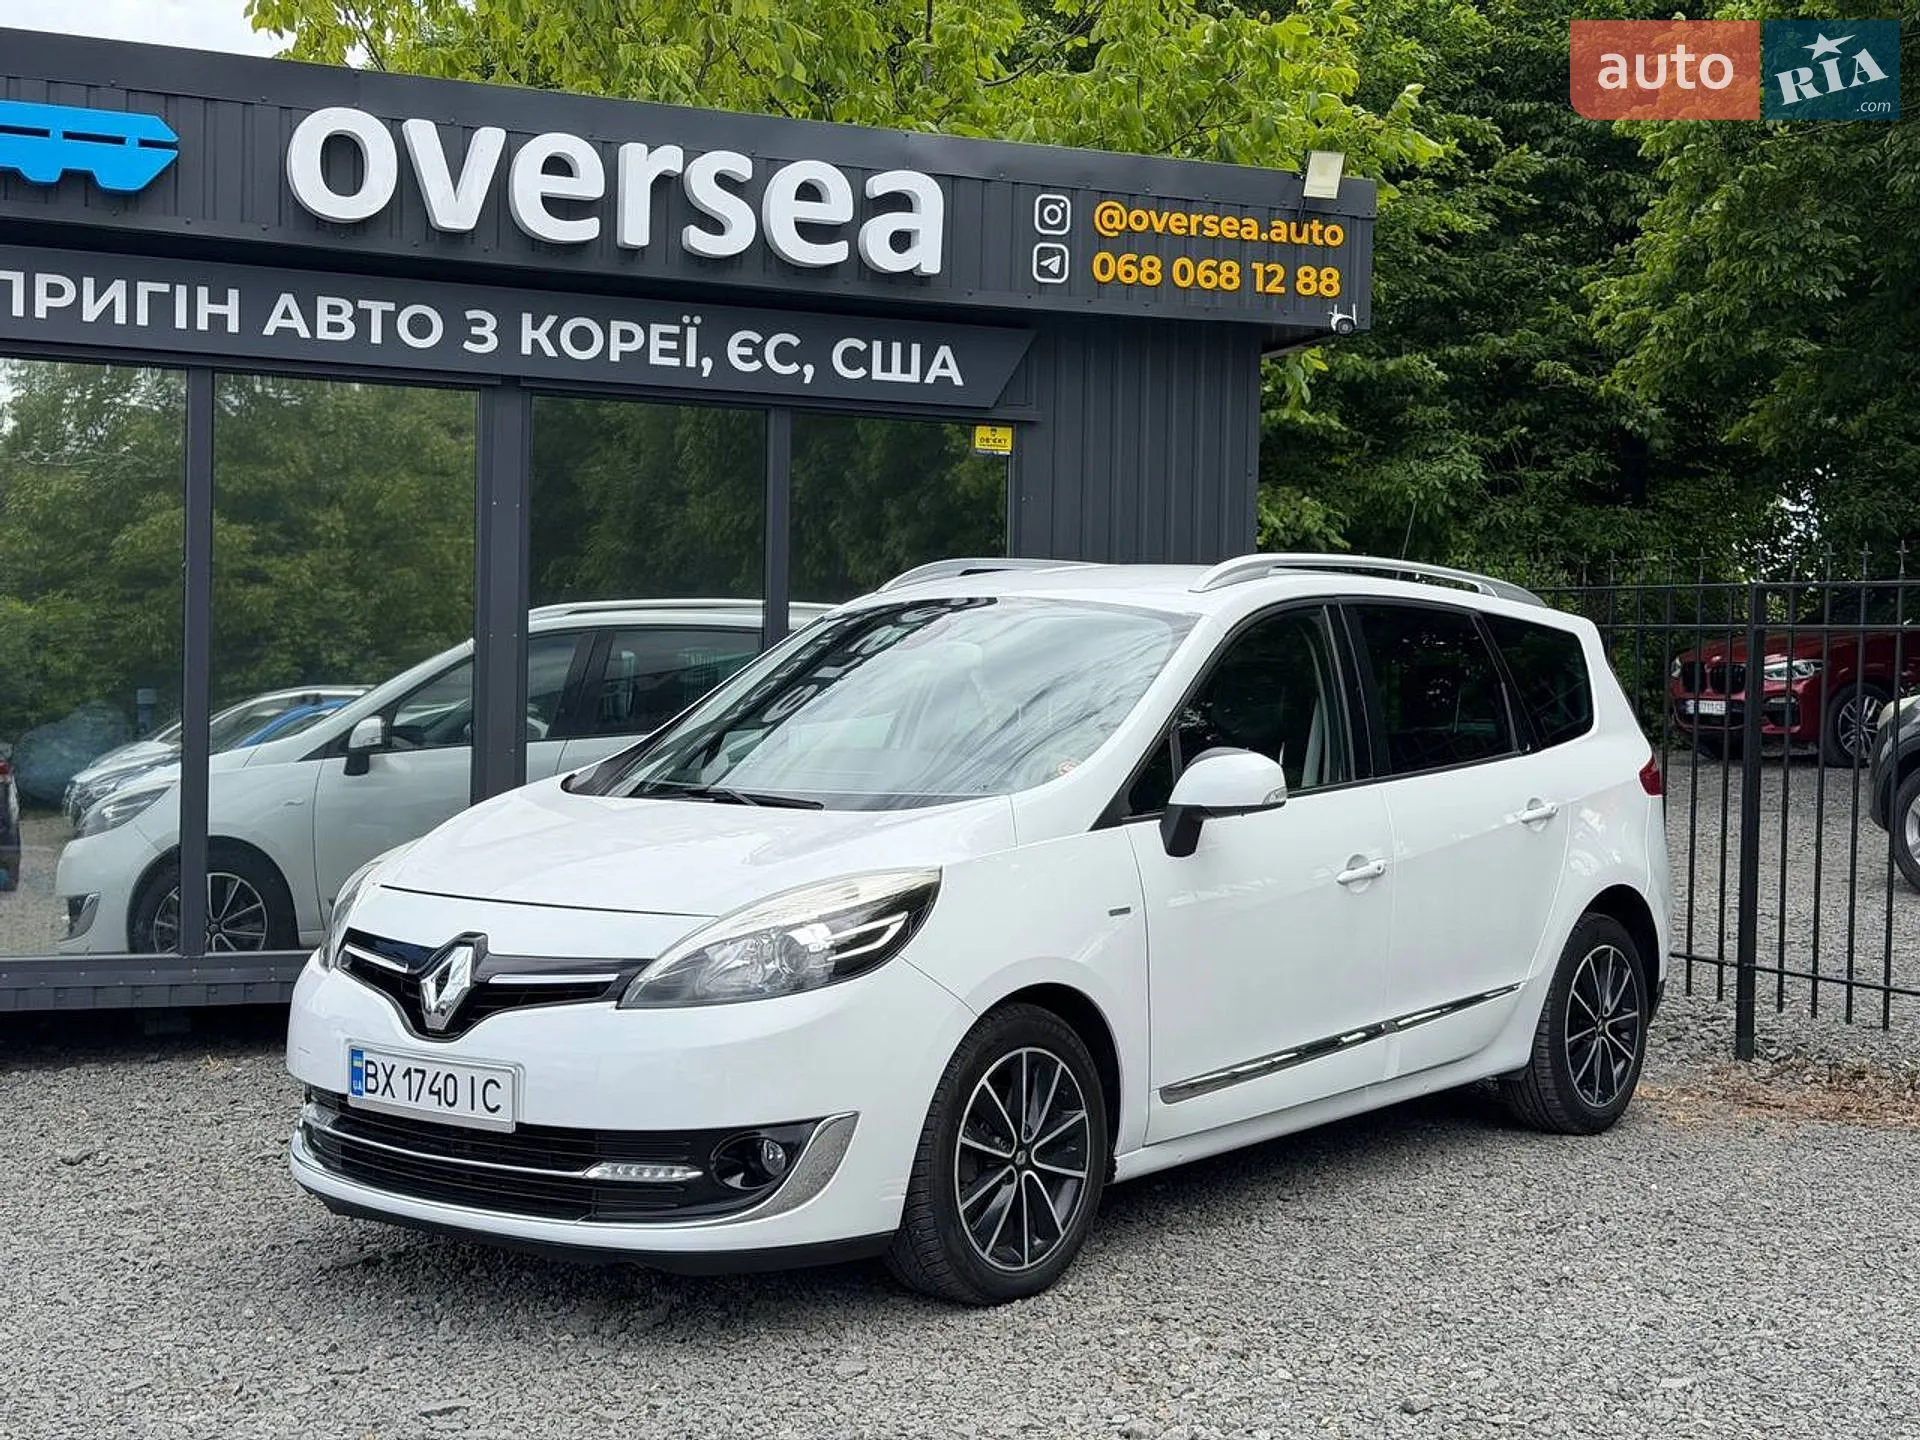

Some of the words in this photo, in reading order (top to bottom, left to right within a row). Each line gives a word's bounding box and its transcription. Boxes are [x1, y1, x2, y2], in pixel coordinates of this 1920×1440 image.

[286, 106, 946, 277] oversea
[1093, 200, 1345, 247] @oversea.auto
[1092, 251, 1163, 287] 068
[1171, 256, 1241, 291] 068
[1251, 262, 1286, 294] 12
[1295, 265, 1341, 298] 88
[0, 270, 240, 334] ПРИГІН
[262, 293, 444, 349] АВТО
[463, 309, 499, 354] З
[520, 312, 713, 378] КОРЕЇ,
[727, 330, 815, 384] ЄС,
[831, 337, 964, 387] США
[364, 1059, 396, 1099] BX
[402, 1066, 458, 1109] 1740
[470, 1075, 502, 1114] IC
